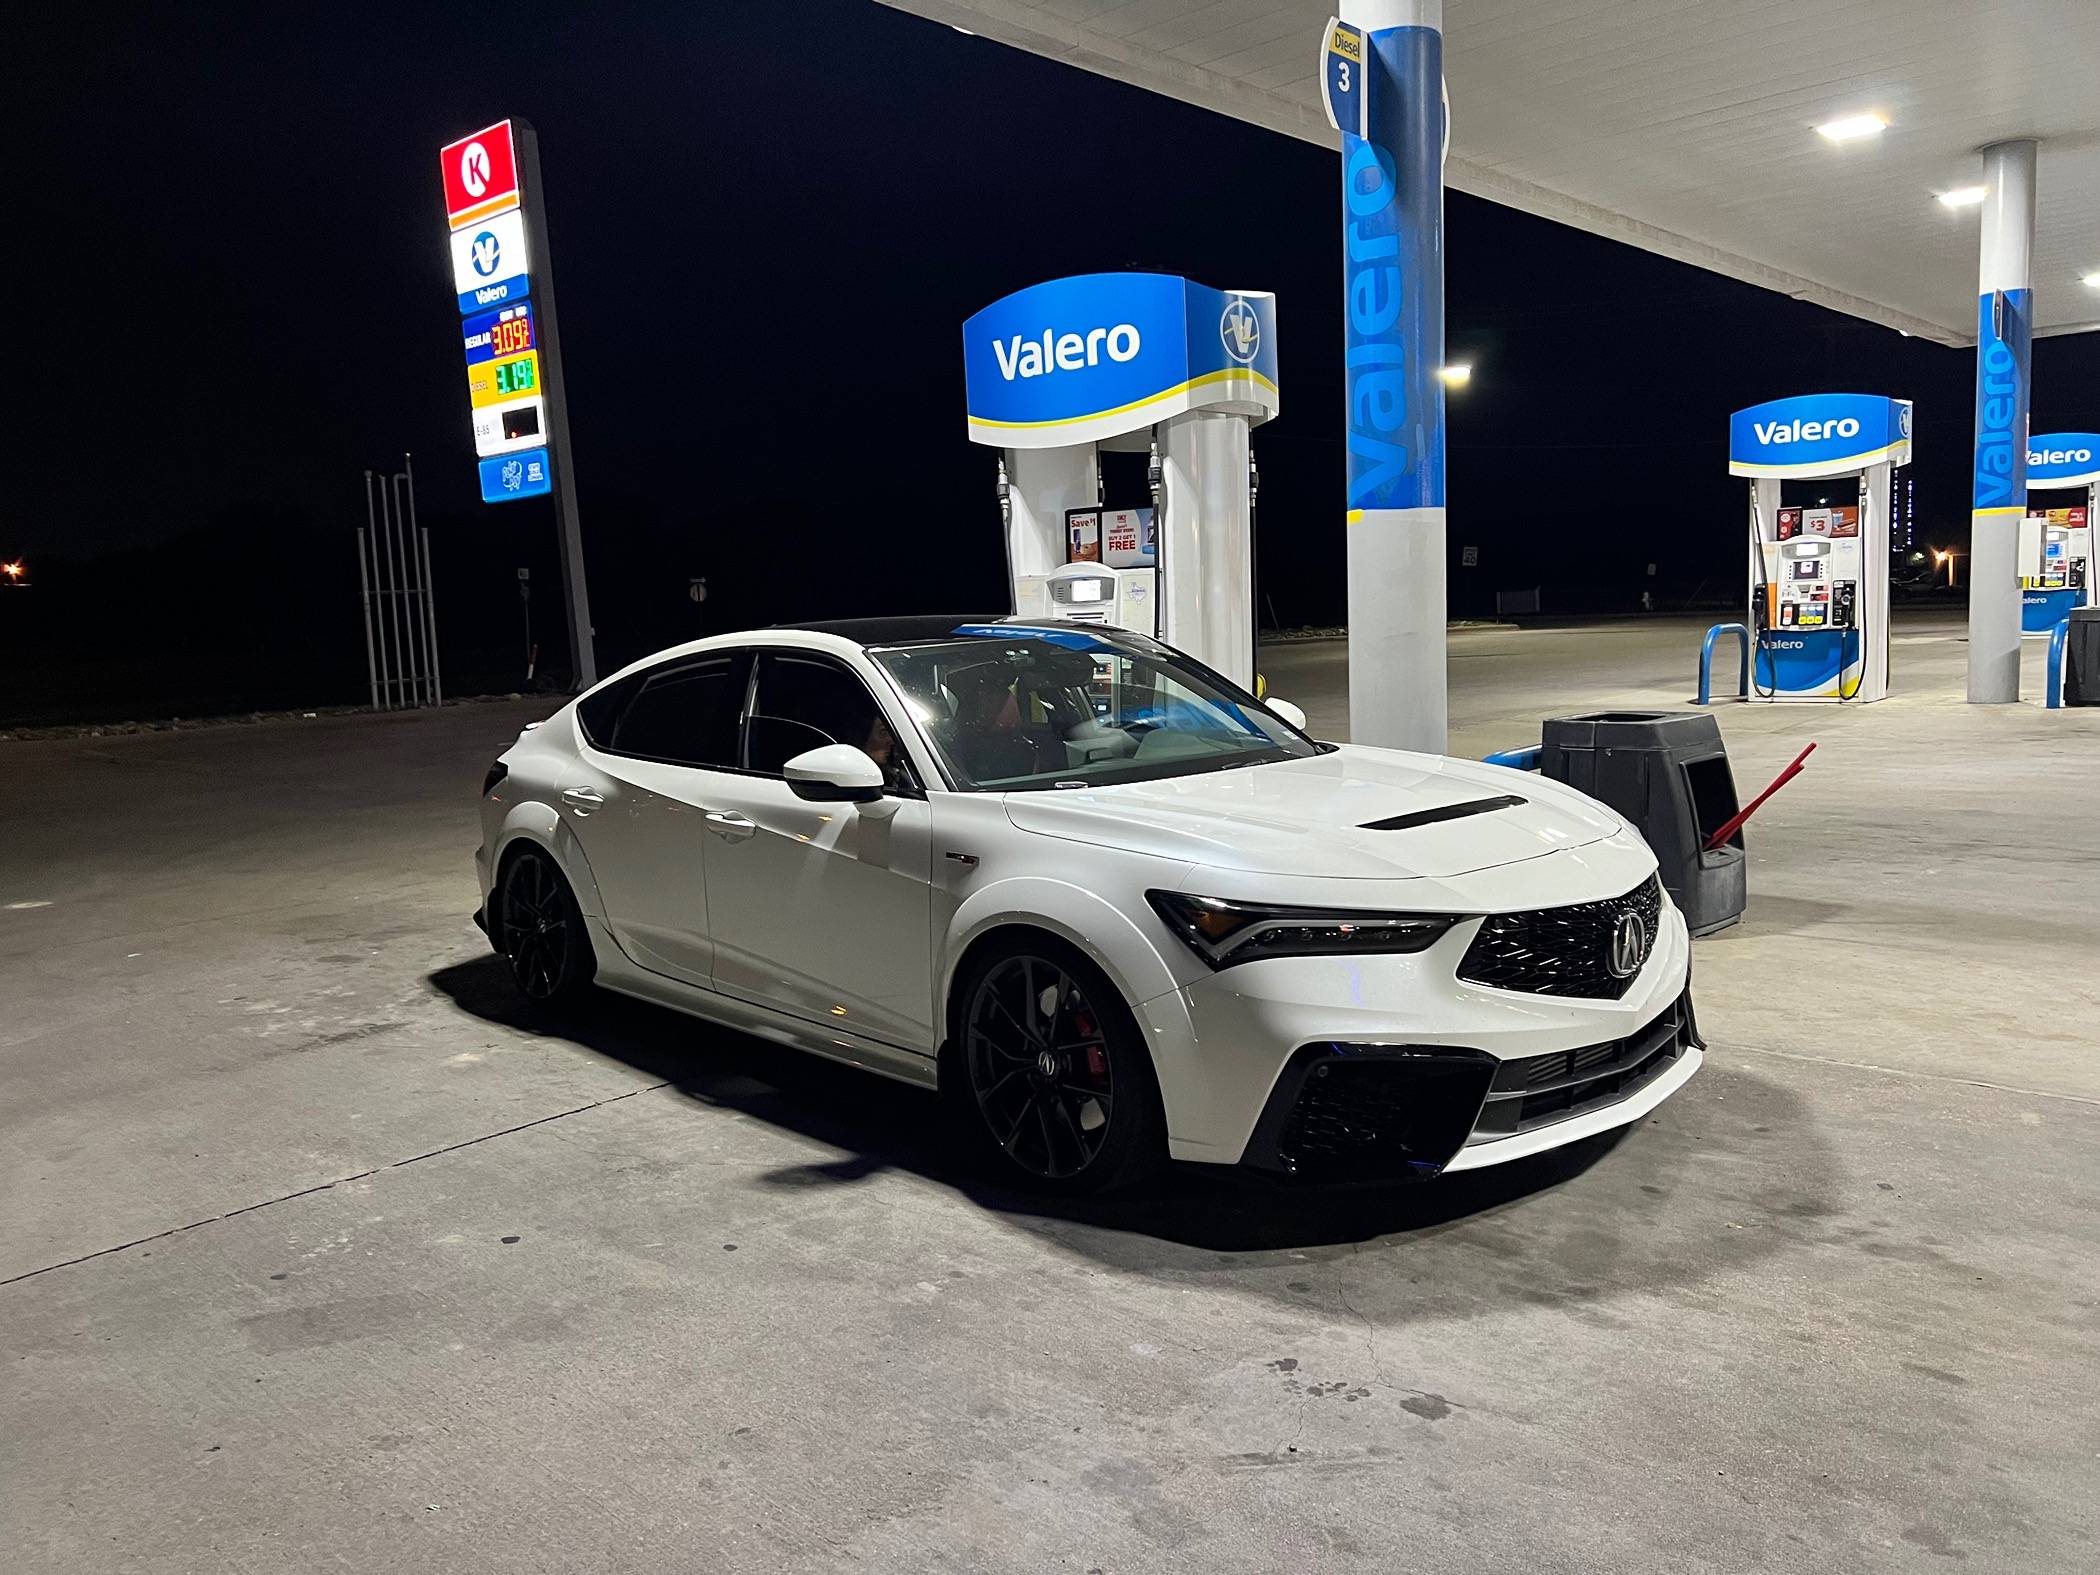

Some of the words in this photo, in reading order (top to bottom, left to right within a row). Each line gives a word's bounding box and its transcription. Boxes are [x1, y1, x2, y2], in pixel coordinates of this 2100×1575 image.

[1335, 32, 1360, 57] Diesel
[1338, 62, 1350, 92] 3
[475, 284, 508, 305] Valero
[1347, 143, 1408, 508] Valero
[992, 323, 1141, 381] Valero
[1753, 418, 1860, 445] Valero
[1975, 341, 2015, 508] Valero
[1071, 518, 1090, 528] Save
[1810, 519, 1825, 532] $3
[1108, 540, 1136, 551] FREE
[1761, 639, 1804, 650] Valero
